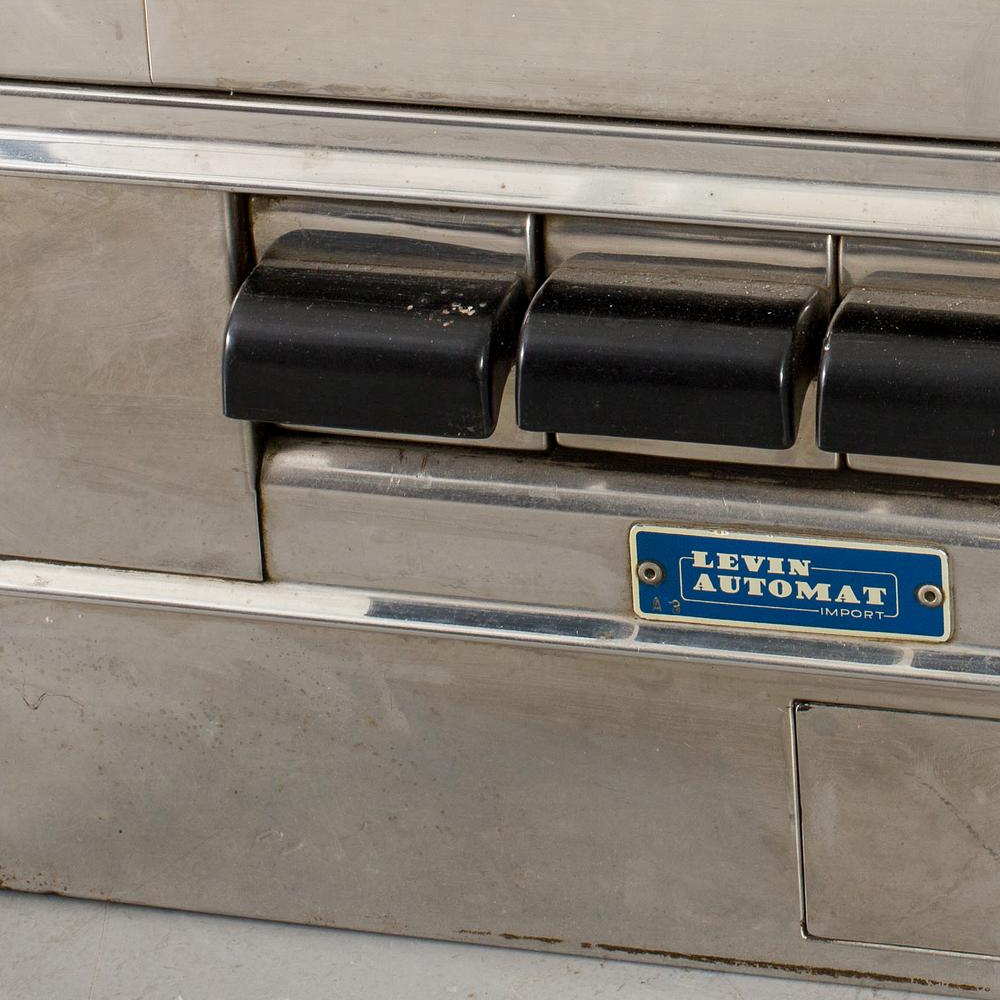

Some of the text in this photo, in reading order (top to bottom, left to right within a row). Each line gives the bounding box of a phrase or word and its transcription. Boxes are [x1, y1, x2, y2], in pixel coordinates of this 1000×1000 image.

[691, 550, 811, 577] LEVIN
[693, 573, 887, 606] AUTOMAT
[820, 607, 885, 620] IMPORT
